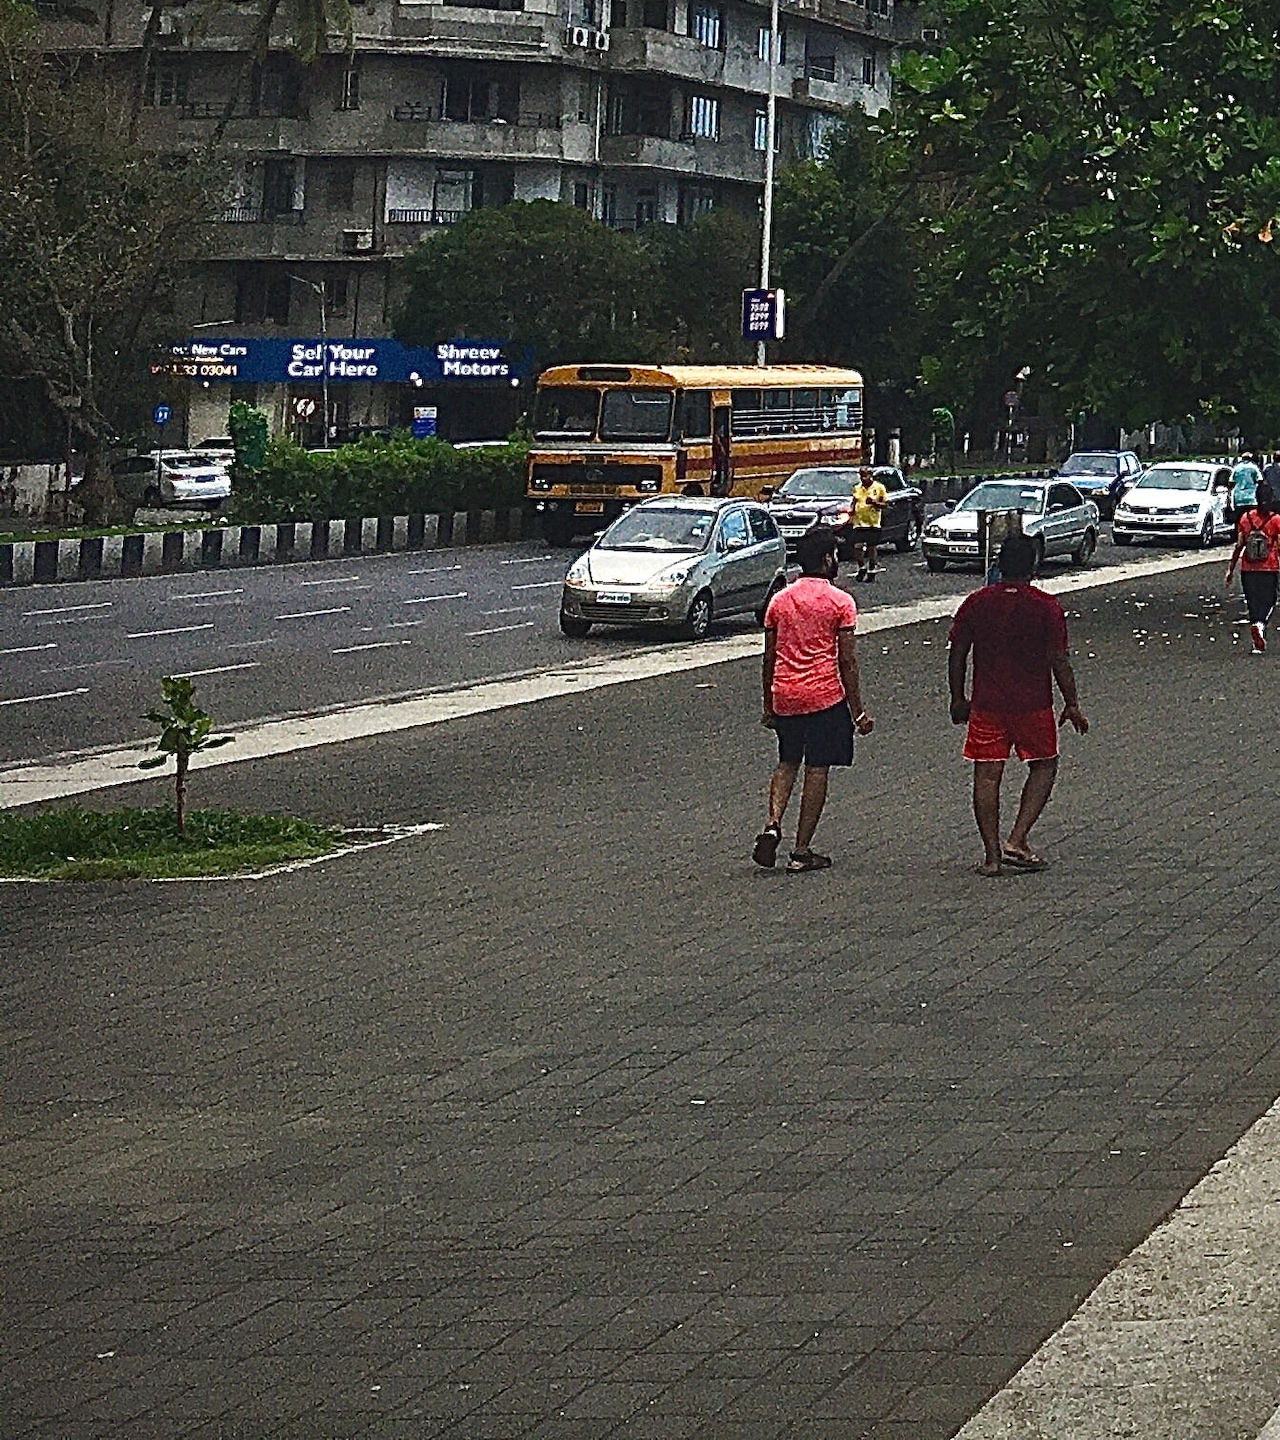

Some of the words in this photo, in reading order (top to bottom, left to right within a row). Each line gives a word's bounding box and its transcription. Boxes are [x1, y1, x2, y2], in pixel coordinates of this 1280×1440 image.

[192, 344, 218, 355] New
[220, 344, 247, 355] Cars
[329, 344, 375, 360] Your
[437, 344, 506, 359] Shreev
[287, 361, 324, 376] Car
[329, 361, 378, 377] Here
[443, 361, 509, 376] Motors
